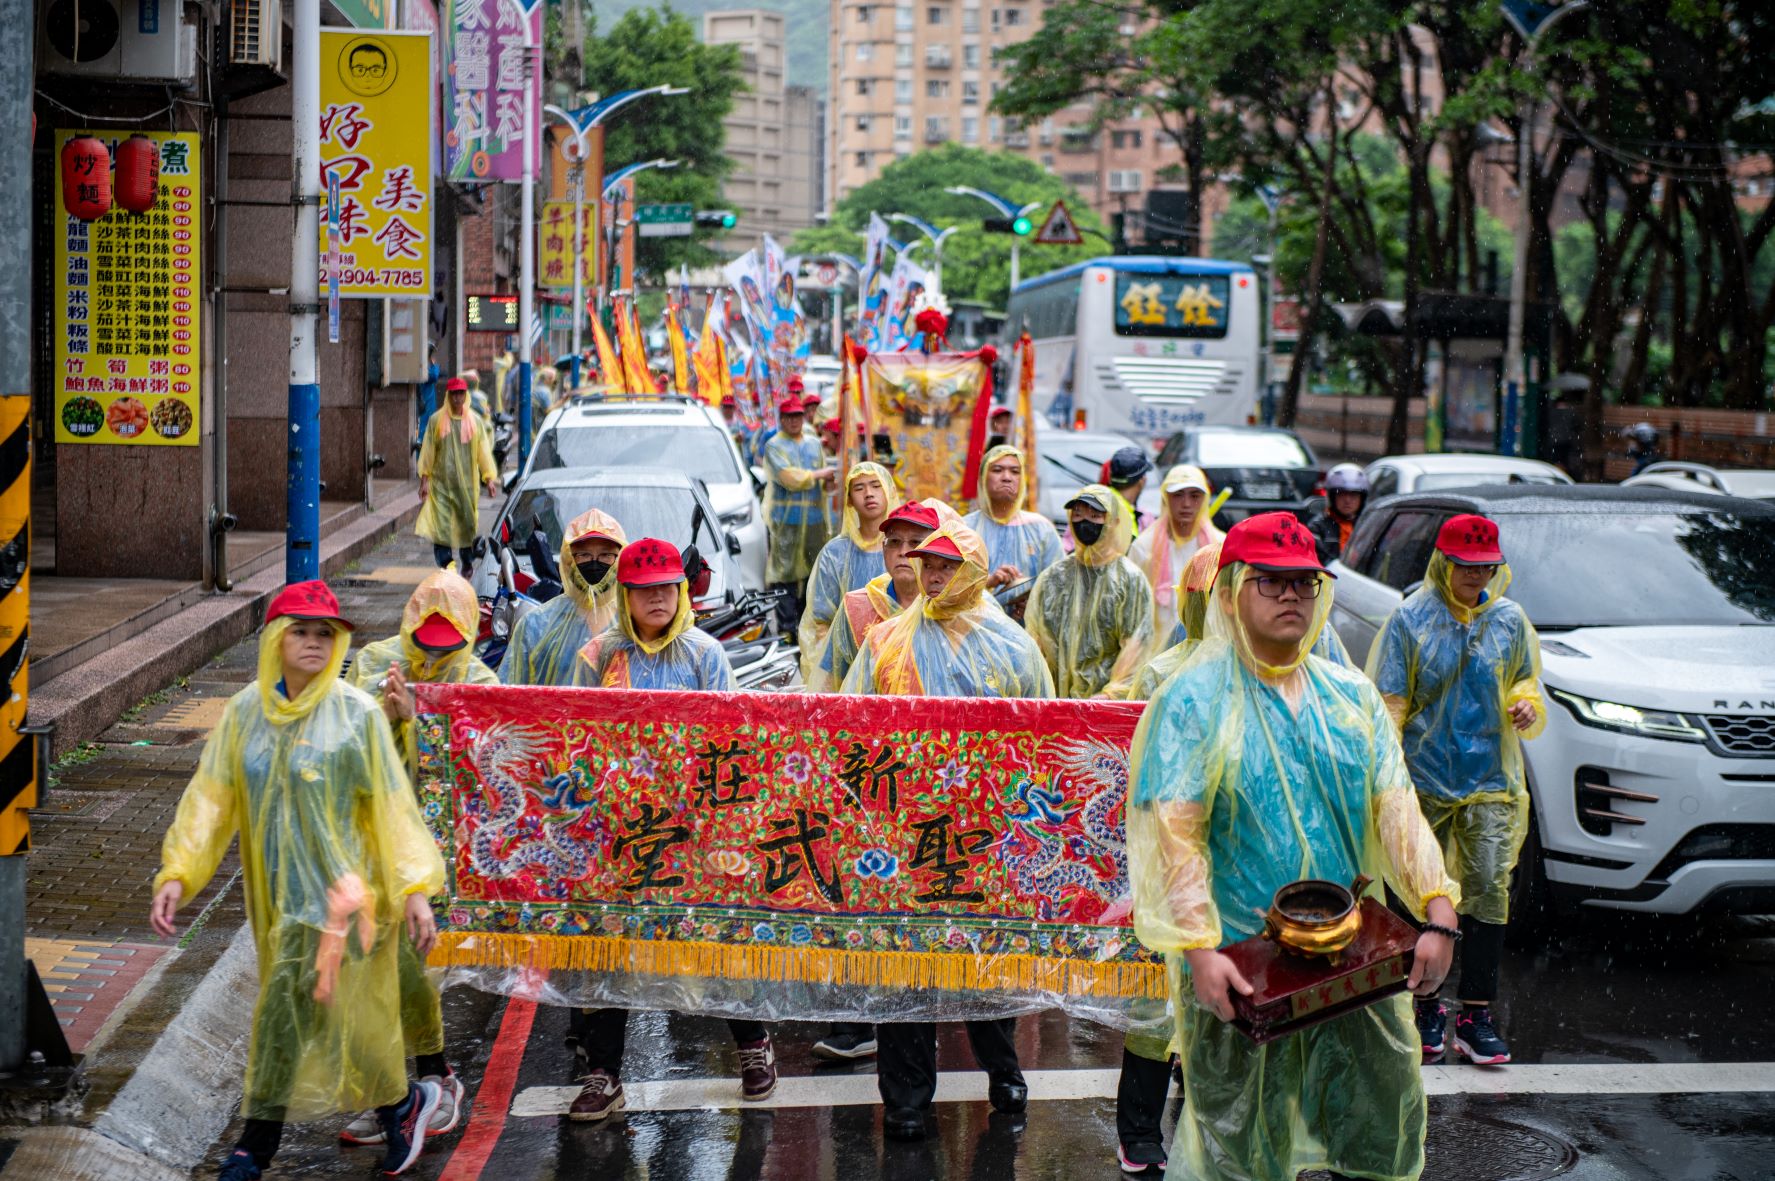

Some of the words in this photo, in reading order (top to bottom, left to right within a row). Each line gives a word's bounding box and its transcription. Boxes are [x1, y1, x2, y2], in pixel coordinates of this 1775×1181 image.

[175, 188, 189, 196] 70
[174, 203, 189, 211] 90
[375, 168, 423, 257] 美食
[174, 217, 189, 225] 90
[97, 227, 170, 240] 沙茶肉絲
[174, 231, 189, 239] 90
[97, 241, 170, 254] 茄汁肉絲
[174, 245, 189, 253] 90
[97, 256, 170, 269] 雪菜肉絲
[174, 260, 189, 268] 90
[174, 274, 189, 282] 90
[97, 285, 170, 298] 泡菜海鮮
[174, 288, 189, 296] 110
[67, 290, 88, 320] 米粉
[97, 299, 170, 312] 沙茶海鮮
[174, 303, 189, 311] 110
[97, 314, 170, 327] 茄汁海鮮
[174, 317, 189, 325] 110
[97, 328, 170, 341] 雪菜海鮮
[174, 332, 189, 340] 110
[174, 346, 189, 354] 110
[65, 377, 169, 393] 鮑魚海鮮粥
[174, 384, 189, 392] 110
